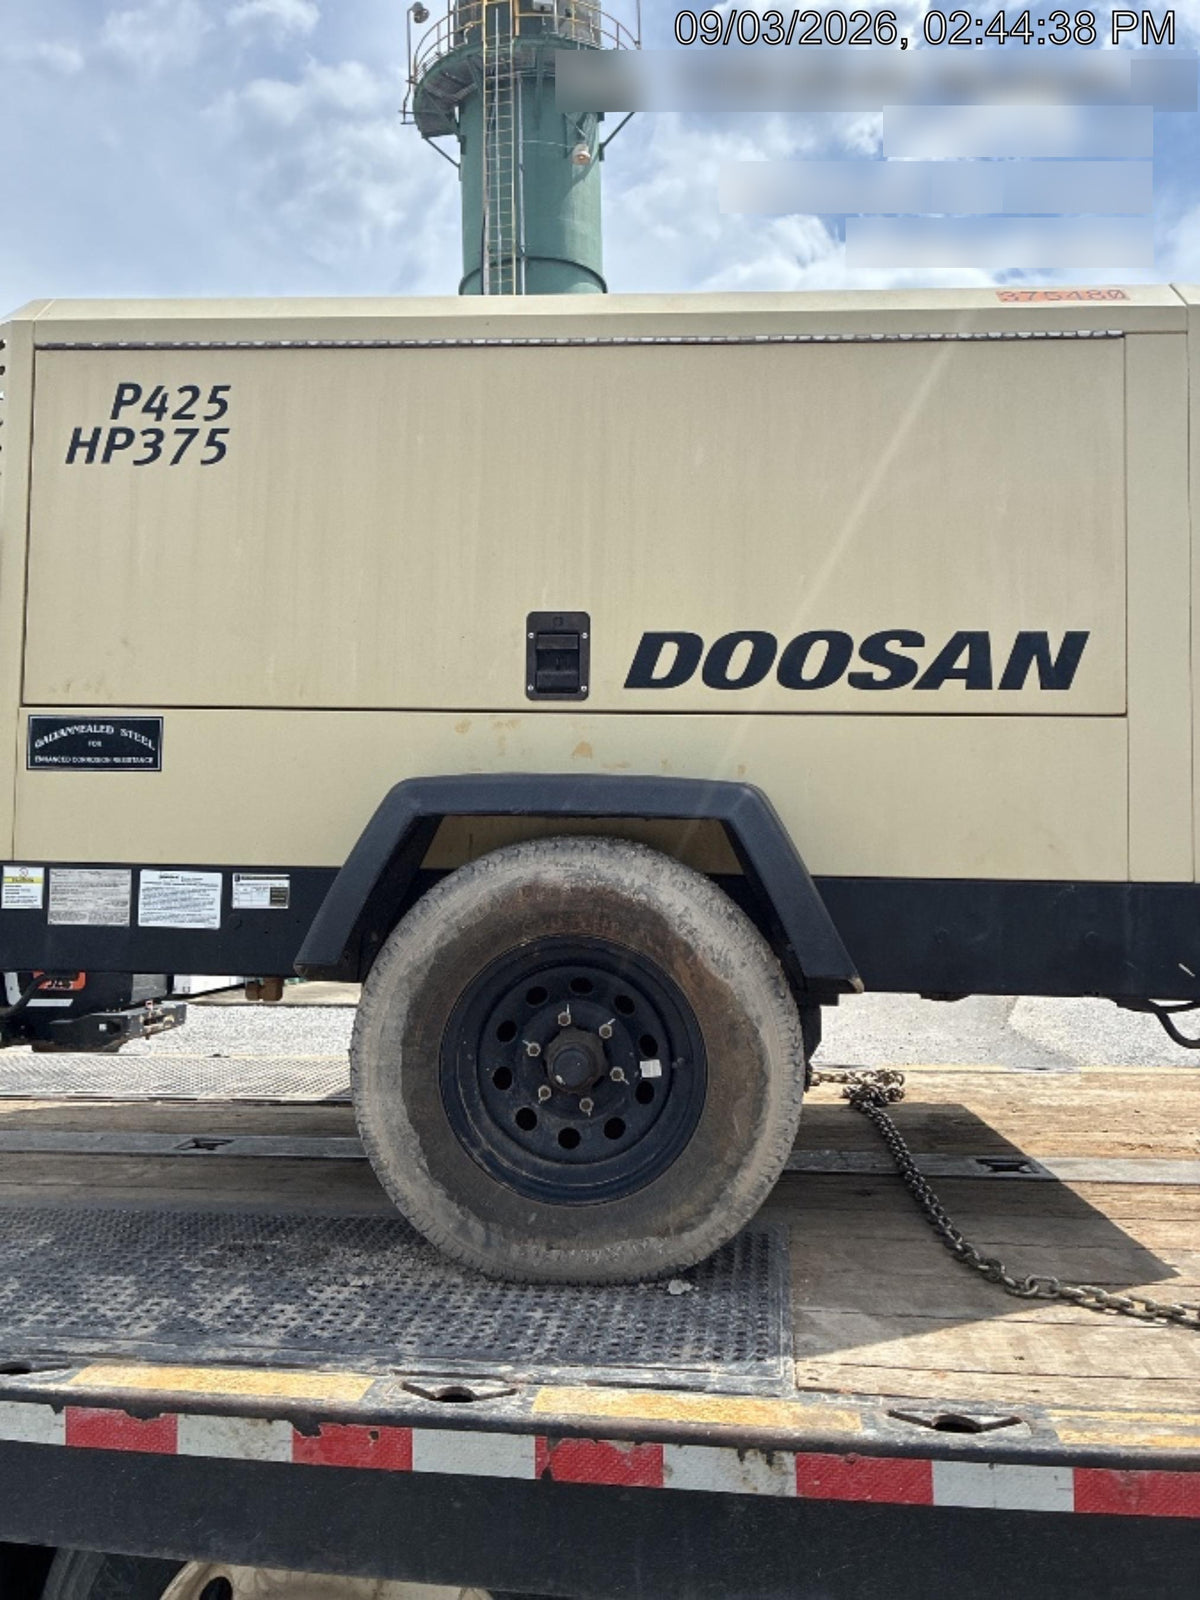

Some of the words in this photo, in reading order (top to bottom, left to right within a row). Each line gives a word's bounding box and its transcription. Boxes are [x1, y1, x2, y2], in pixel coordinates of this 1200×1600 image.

[110, 382, 231, 422] P425
[65, 426, 230, 466] HP375
[623, 629, 1091, 691] DOOSAN
[87, 740, 102, 748] FOR
[120, 728, 156, 751] STEEL
